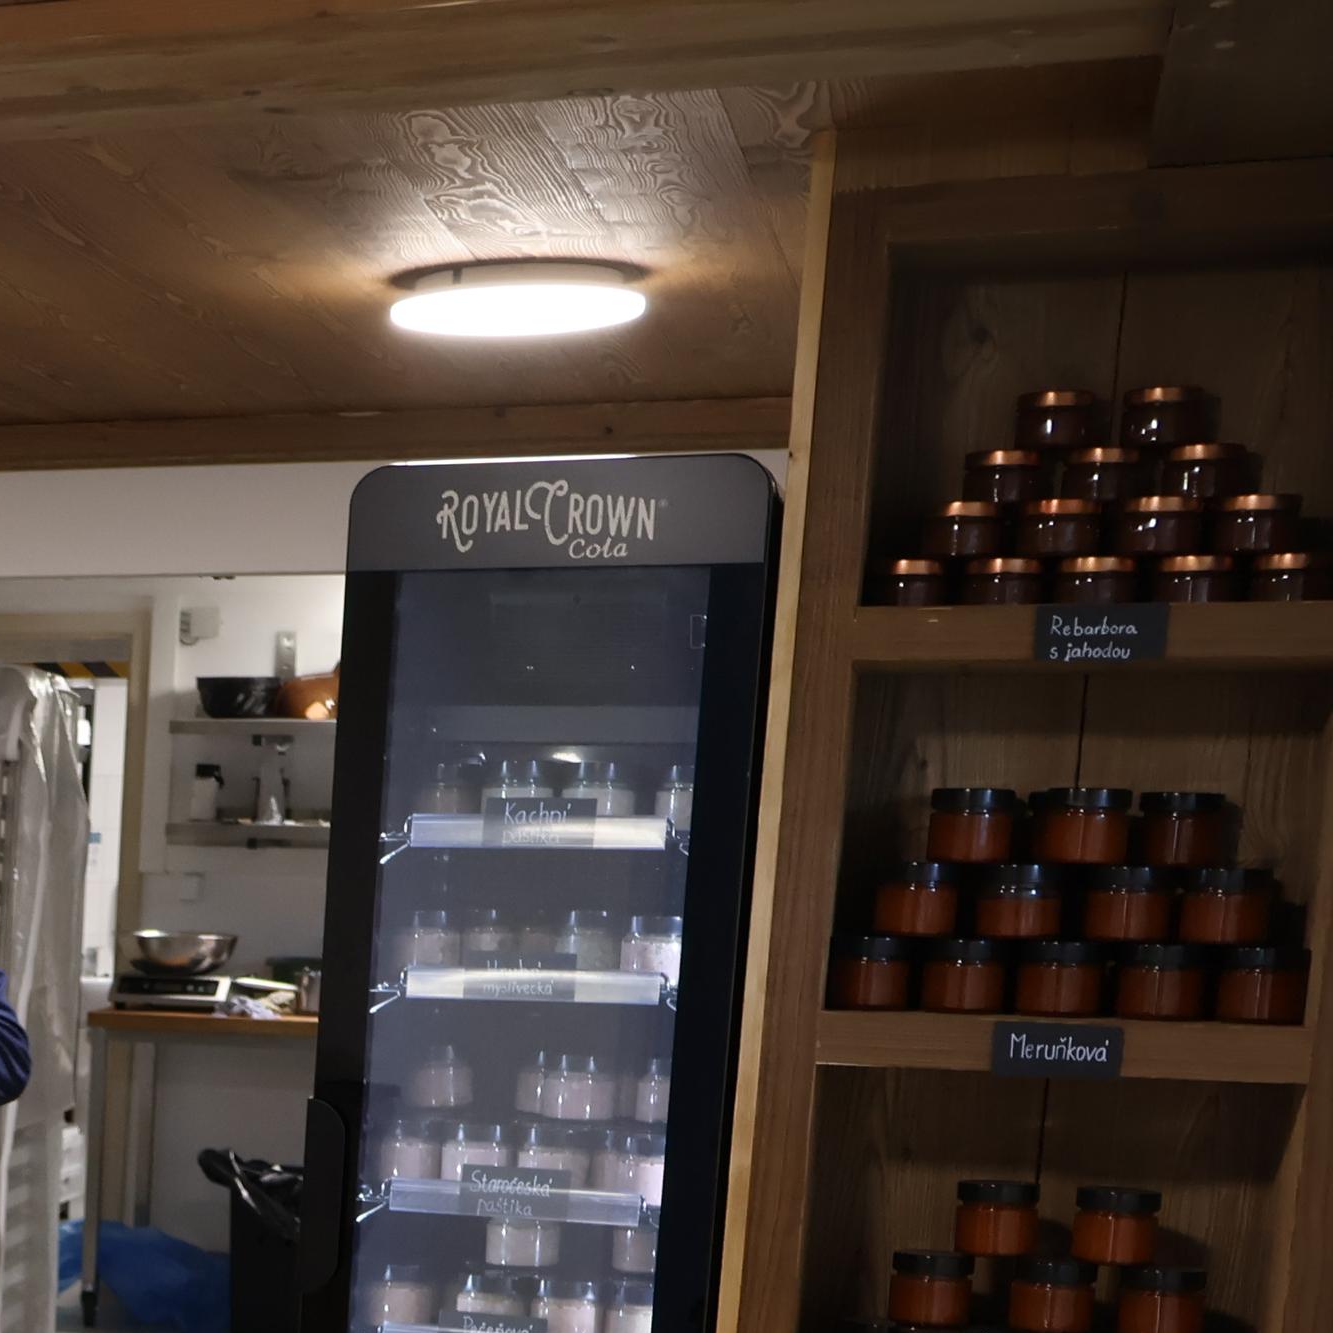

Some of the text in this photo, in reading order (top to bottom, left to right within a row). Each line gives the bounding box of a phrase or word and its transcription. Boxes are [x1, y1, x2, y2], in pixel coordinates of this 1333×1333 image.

[436, 480, 656, 552] ROYAL CROWN
[568, 536, 628, 558] Cola
[1050, 614, 1138, 637] Rebarbora
[1049, 640, 1131, 662] s jahodou
[1009, 1032, 1110, 1062] Meruňková
